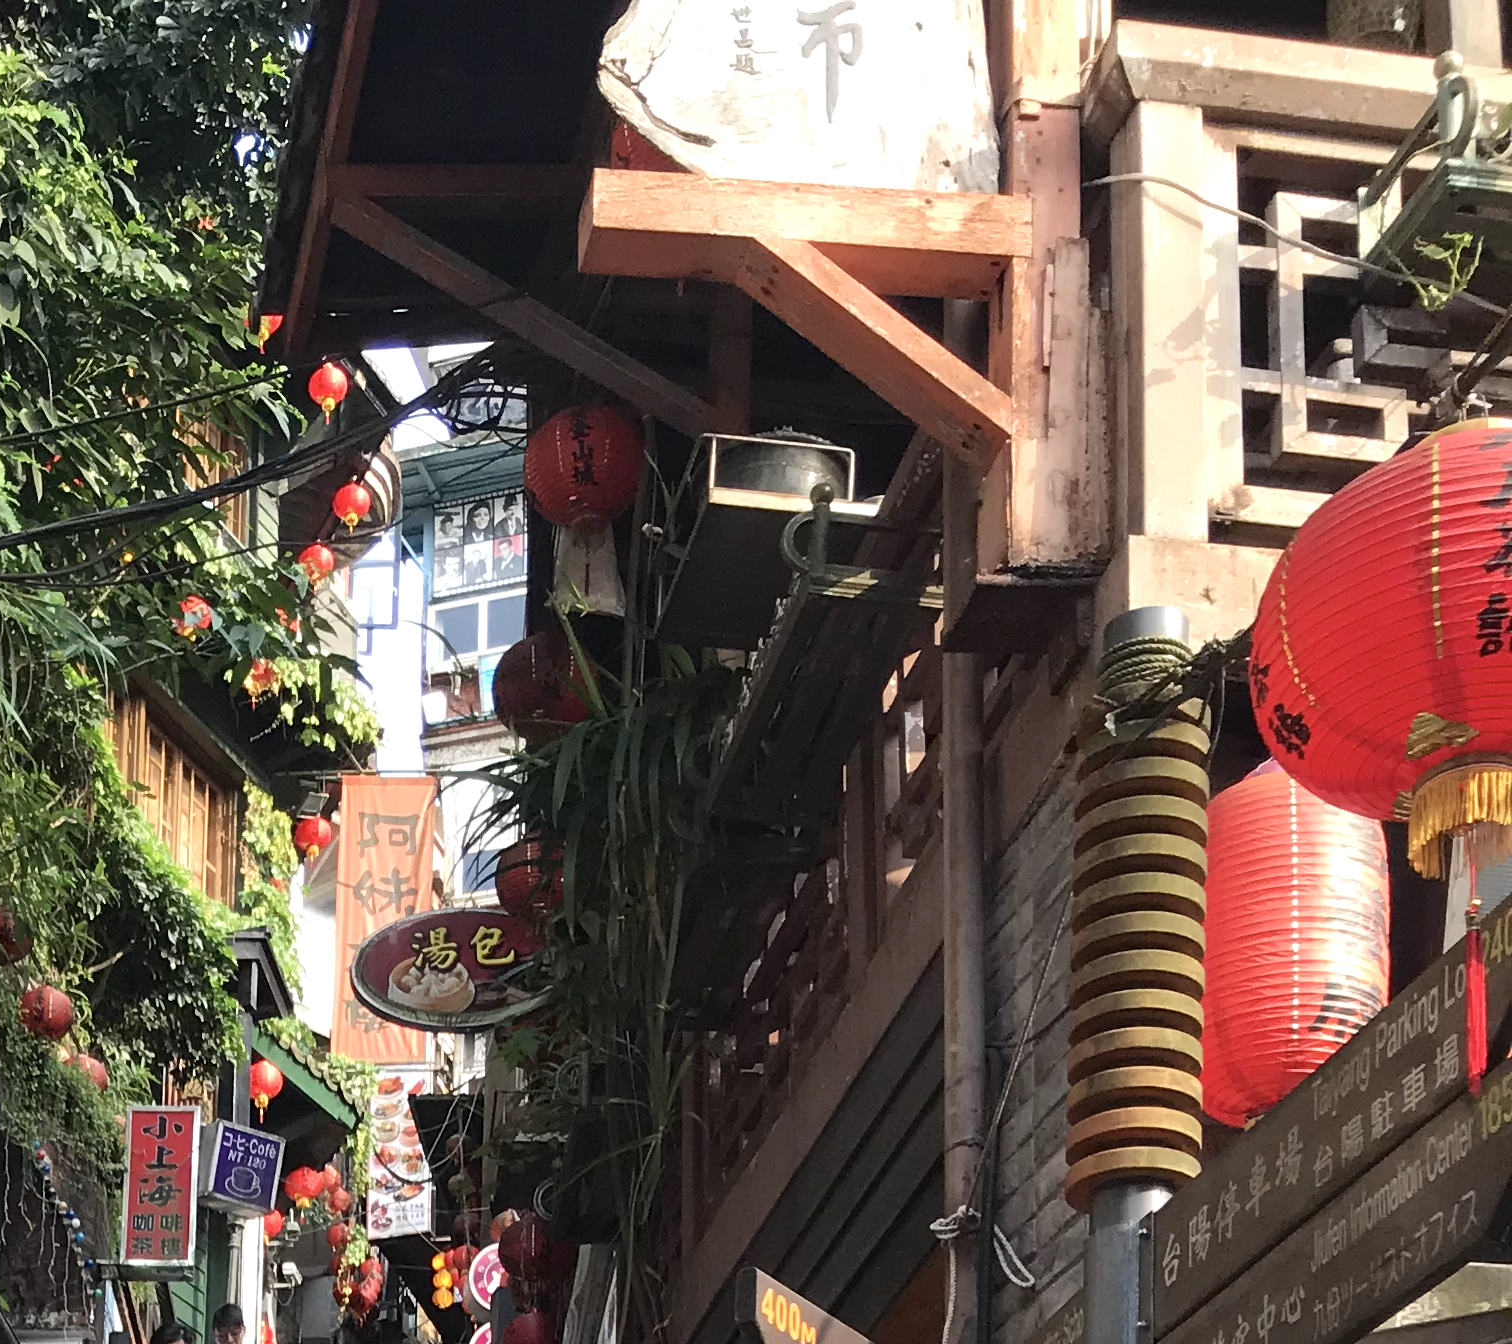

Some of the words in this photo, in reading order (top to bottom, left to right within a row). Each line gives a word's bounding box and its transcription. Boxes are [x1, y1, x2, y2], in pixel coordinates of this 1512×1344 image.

[411, 925, 516, 970] 湯包
[1375, 986, 1439, 1069] Parking
[1444, 961, 1468, 1010] Lo
[138, 1115, 183, 1208] 小上海
[1426, 1114, 1475, 1181] Center
[132, 1213, 183, 1234] 咖啡
